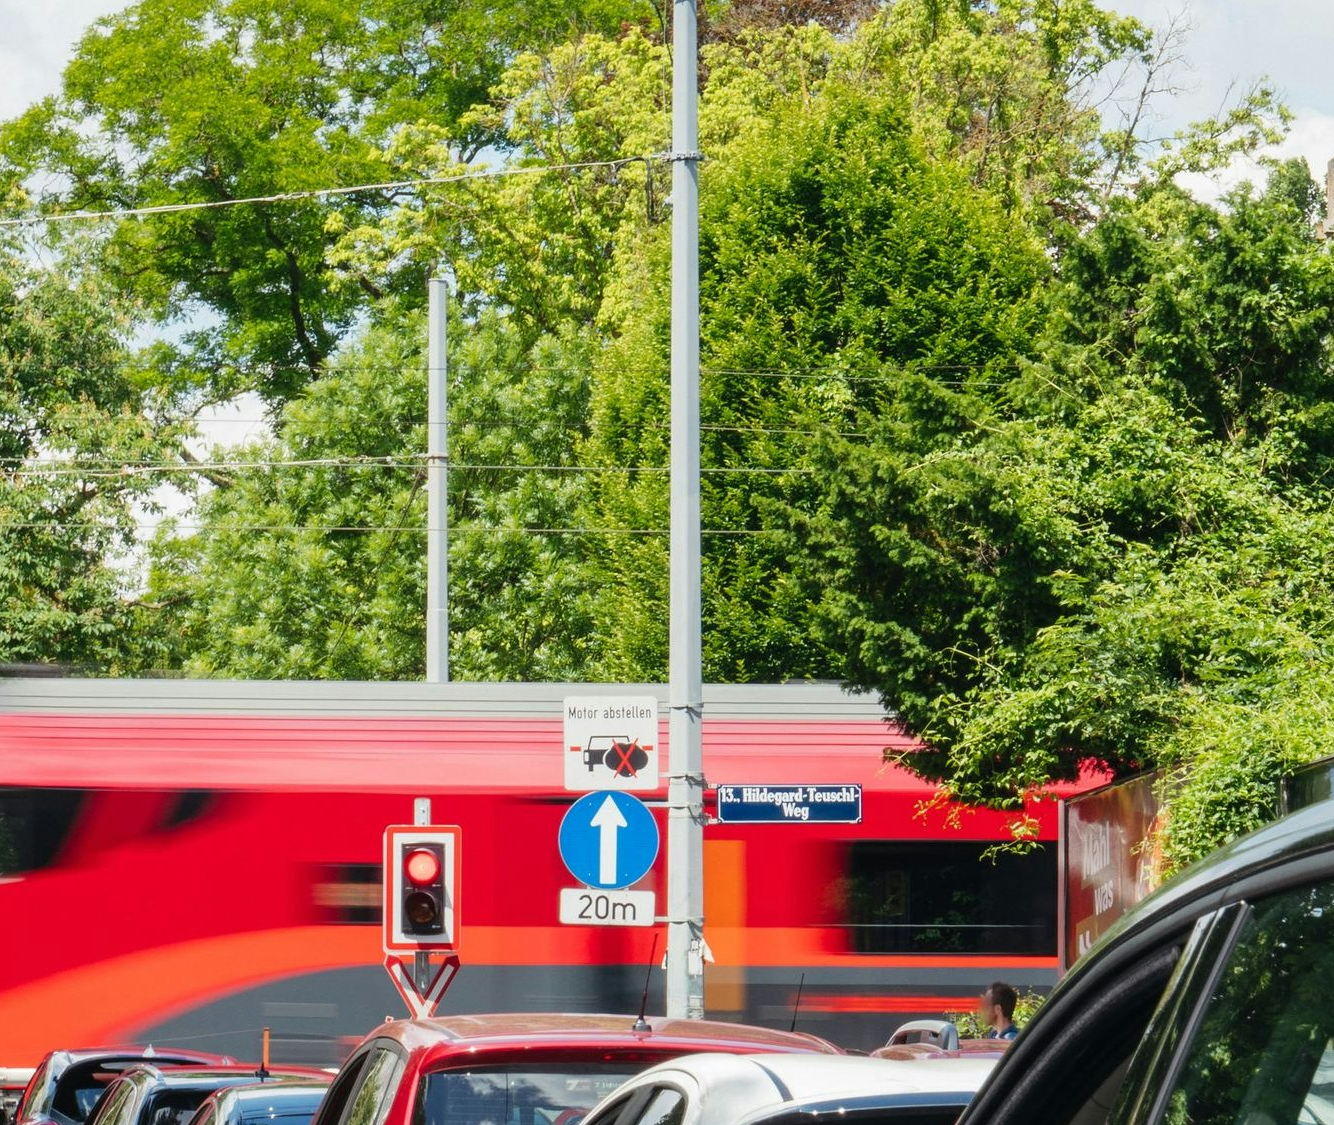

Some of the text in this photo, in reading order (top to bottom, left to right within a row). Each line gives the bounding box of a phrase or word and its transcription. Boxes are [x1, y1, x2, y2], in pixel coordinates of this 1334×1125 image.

[568, 706, 652, 719] Motor abstellen
[720, 788, 860, 806] 13., Hildegard-Teuschl-
[782, 803, 810, 820] Weg
[578, 894, 636, 920] 20m
[1094, 879, 1114, 917] was
